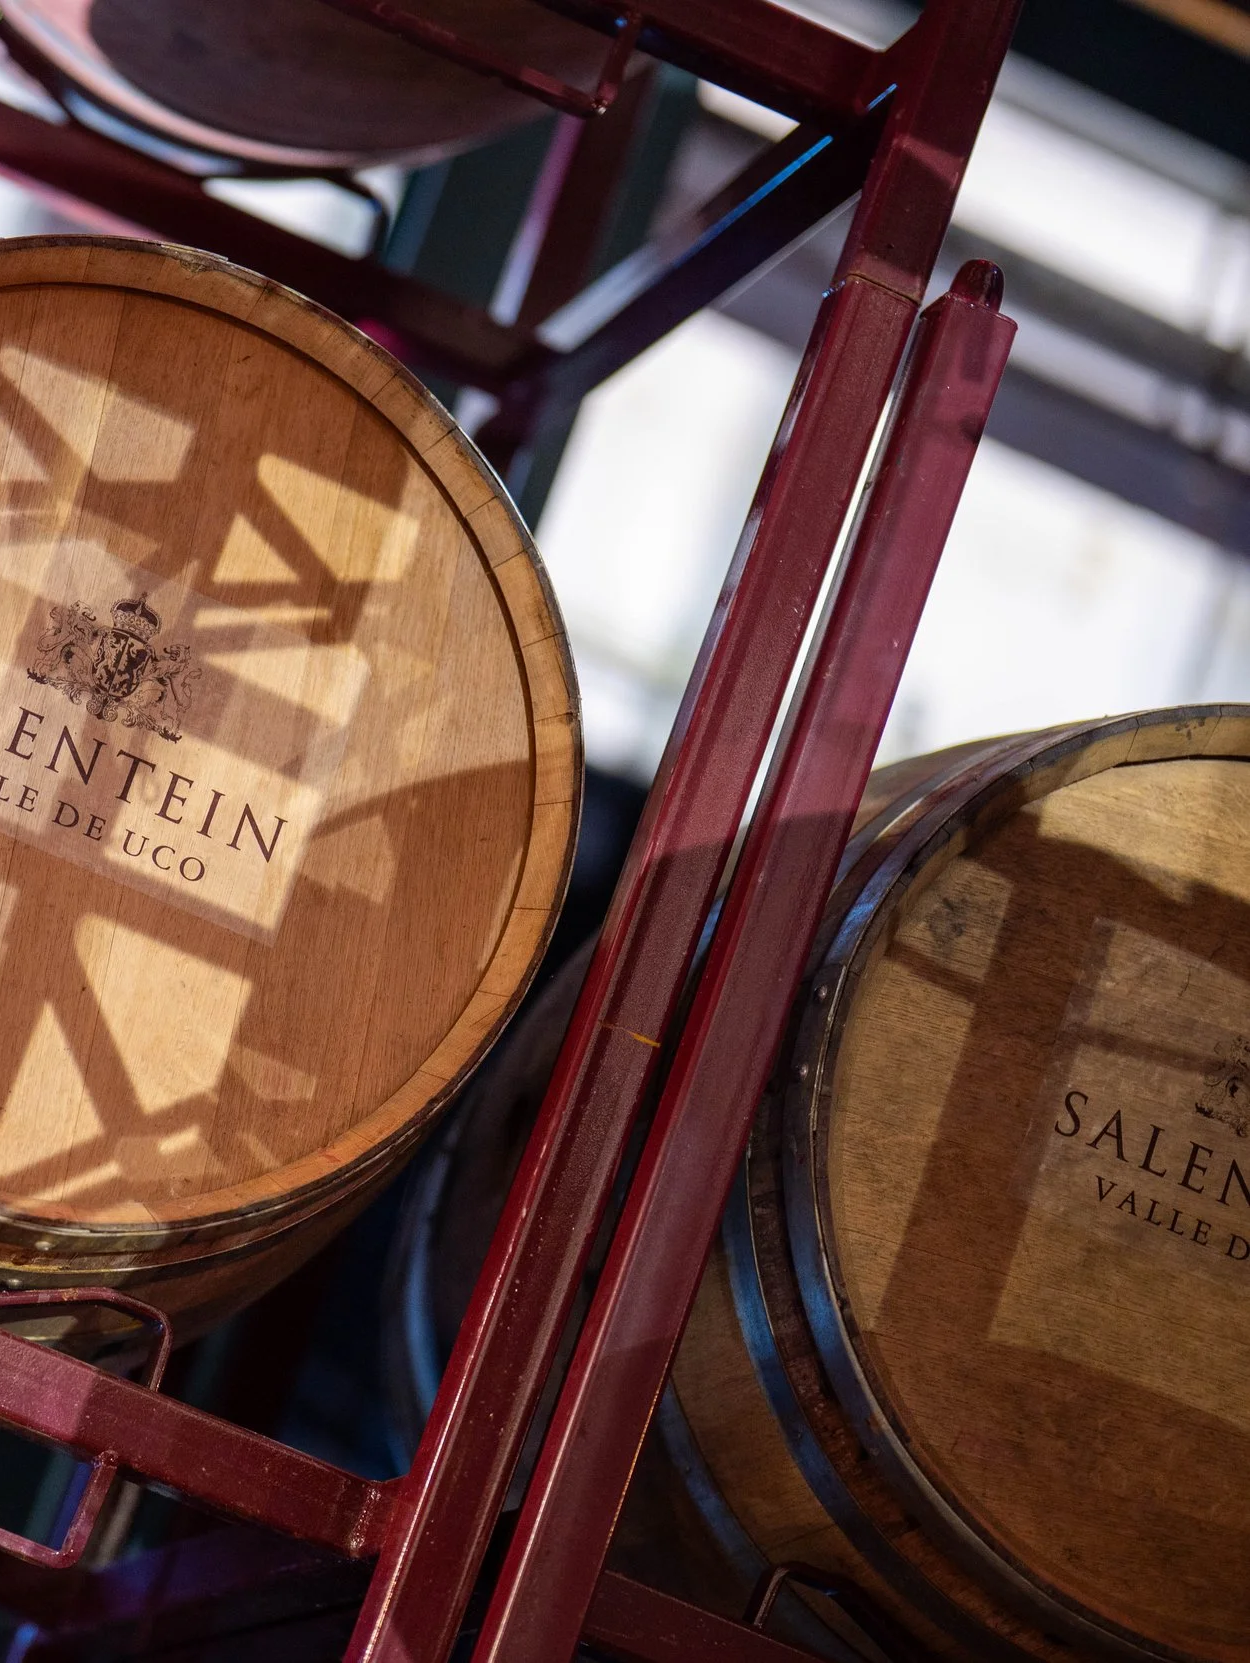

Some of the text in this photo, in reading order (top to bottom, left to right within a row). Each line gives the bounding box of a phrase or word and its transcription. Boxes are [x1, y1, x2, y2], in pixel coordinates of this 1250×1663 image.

[52, 801, 107, 842] DE
[122, 829, 206, 883] UCO
[1095, 1175, 1212, 1247] VALLE
